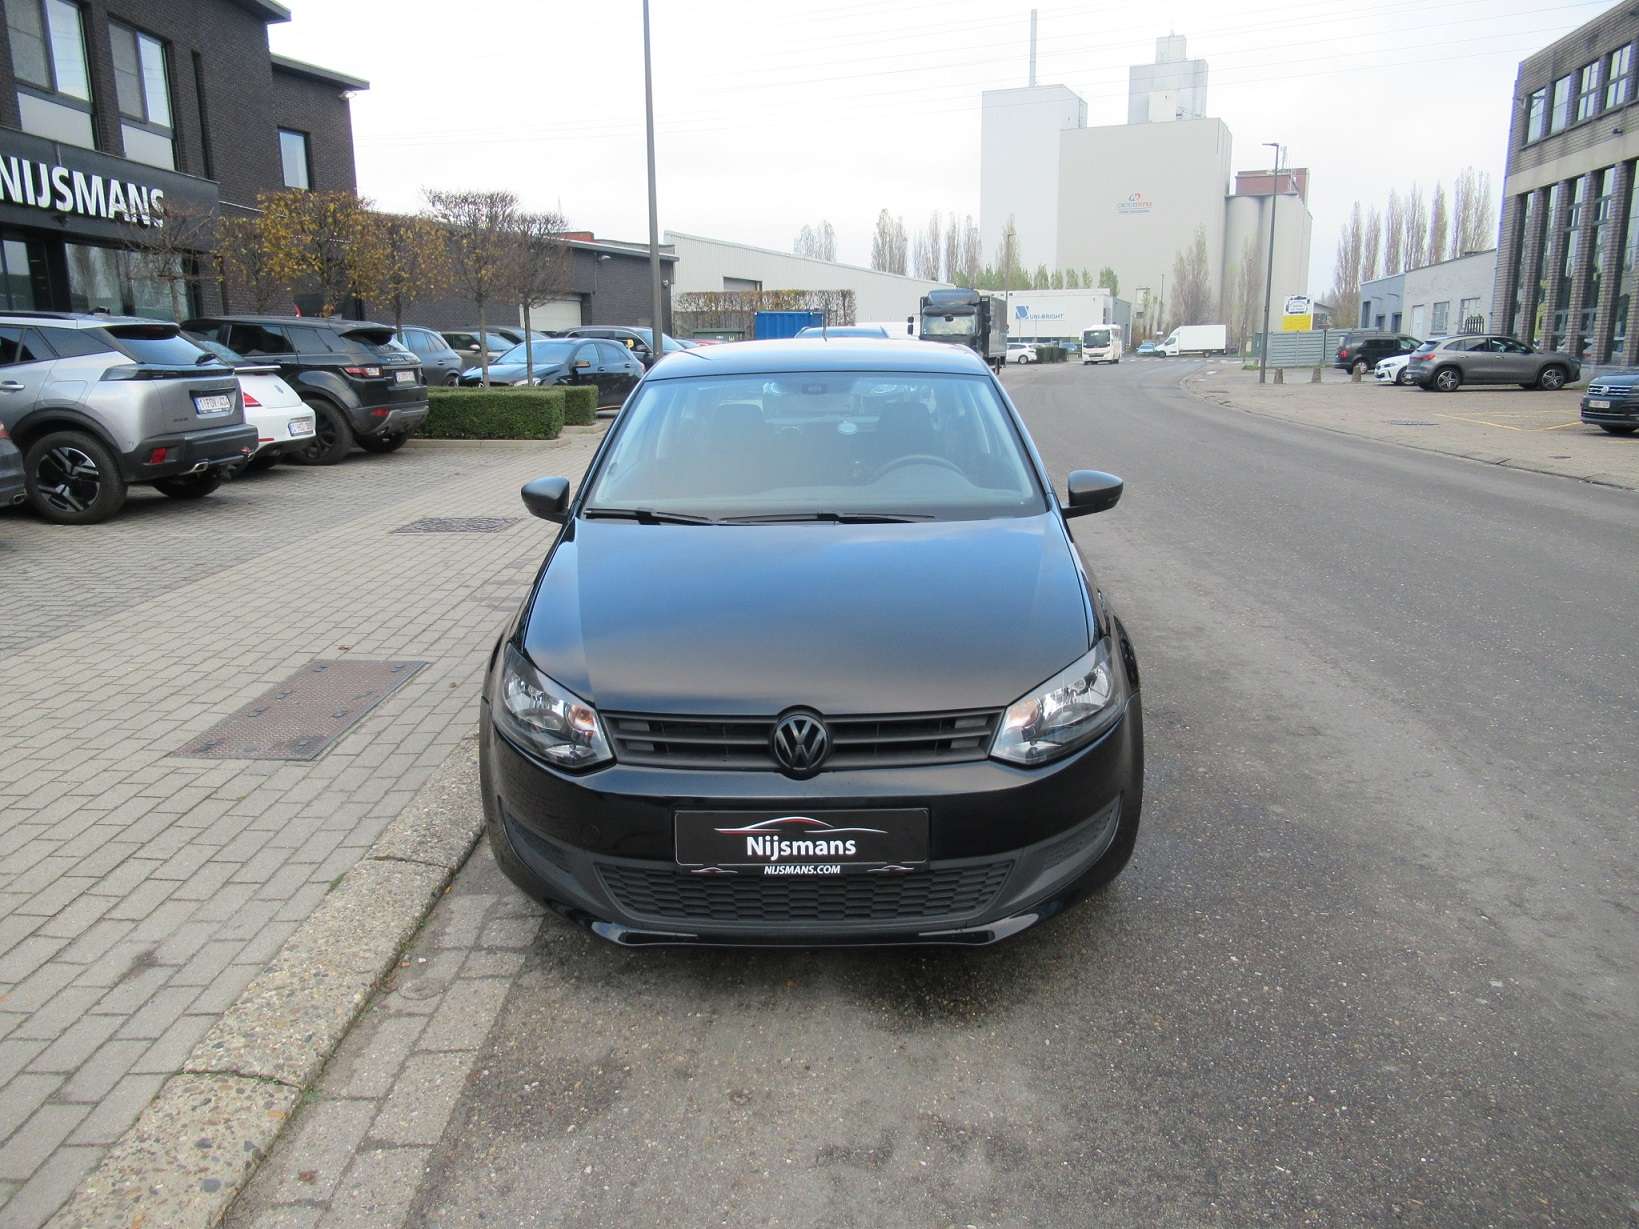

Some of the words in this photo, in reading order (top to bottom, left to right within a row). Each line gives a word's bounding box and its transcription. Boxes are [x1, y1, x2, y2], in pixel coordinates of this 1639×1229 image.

[0, 154, 165, 228] NIJSMANS
[746, 835, 857, 861] Nijsmans
[764, 865, 841, 874] NIJSMANS.COM
